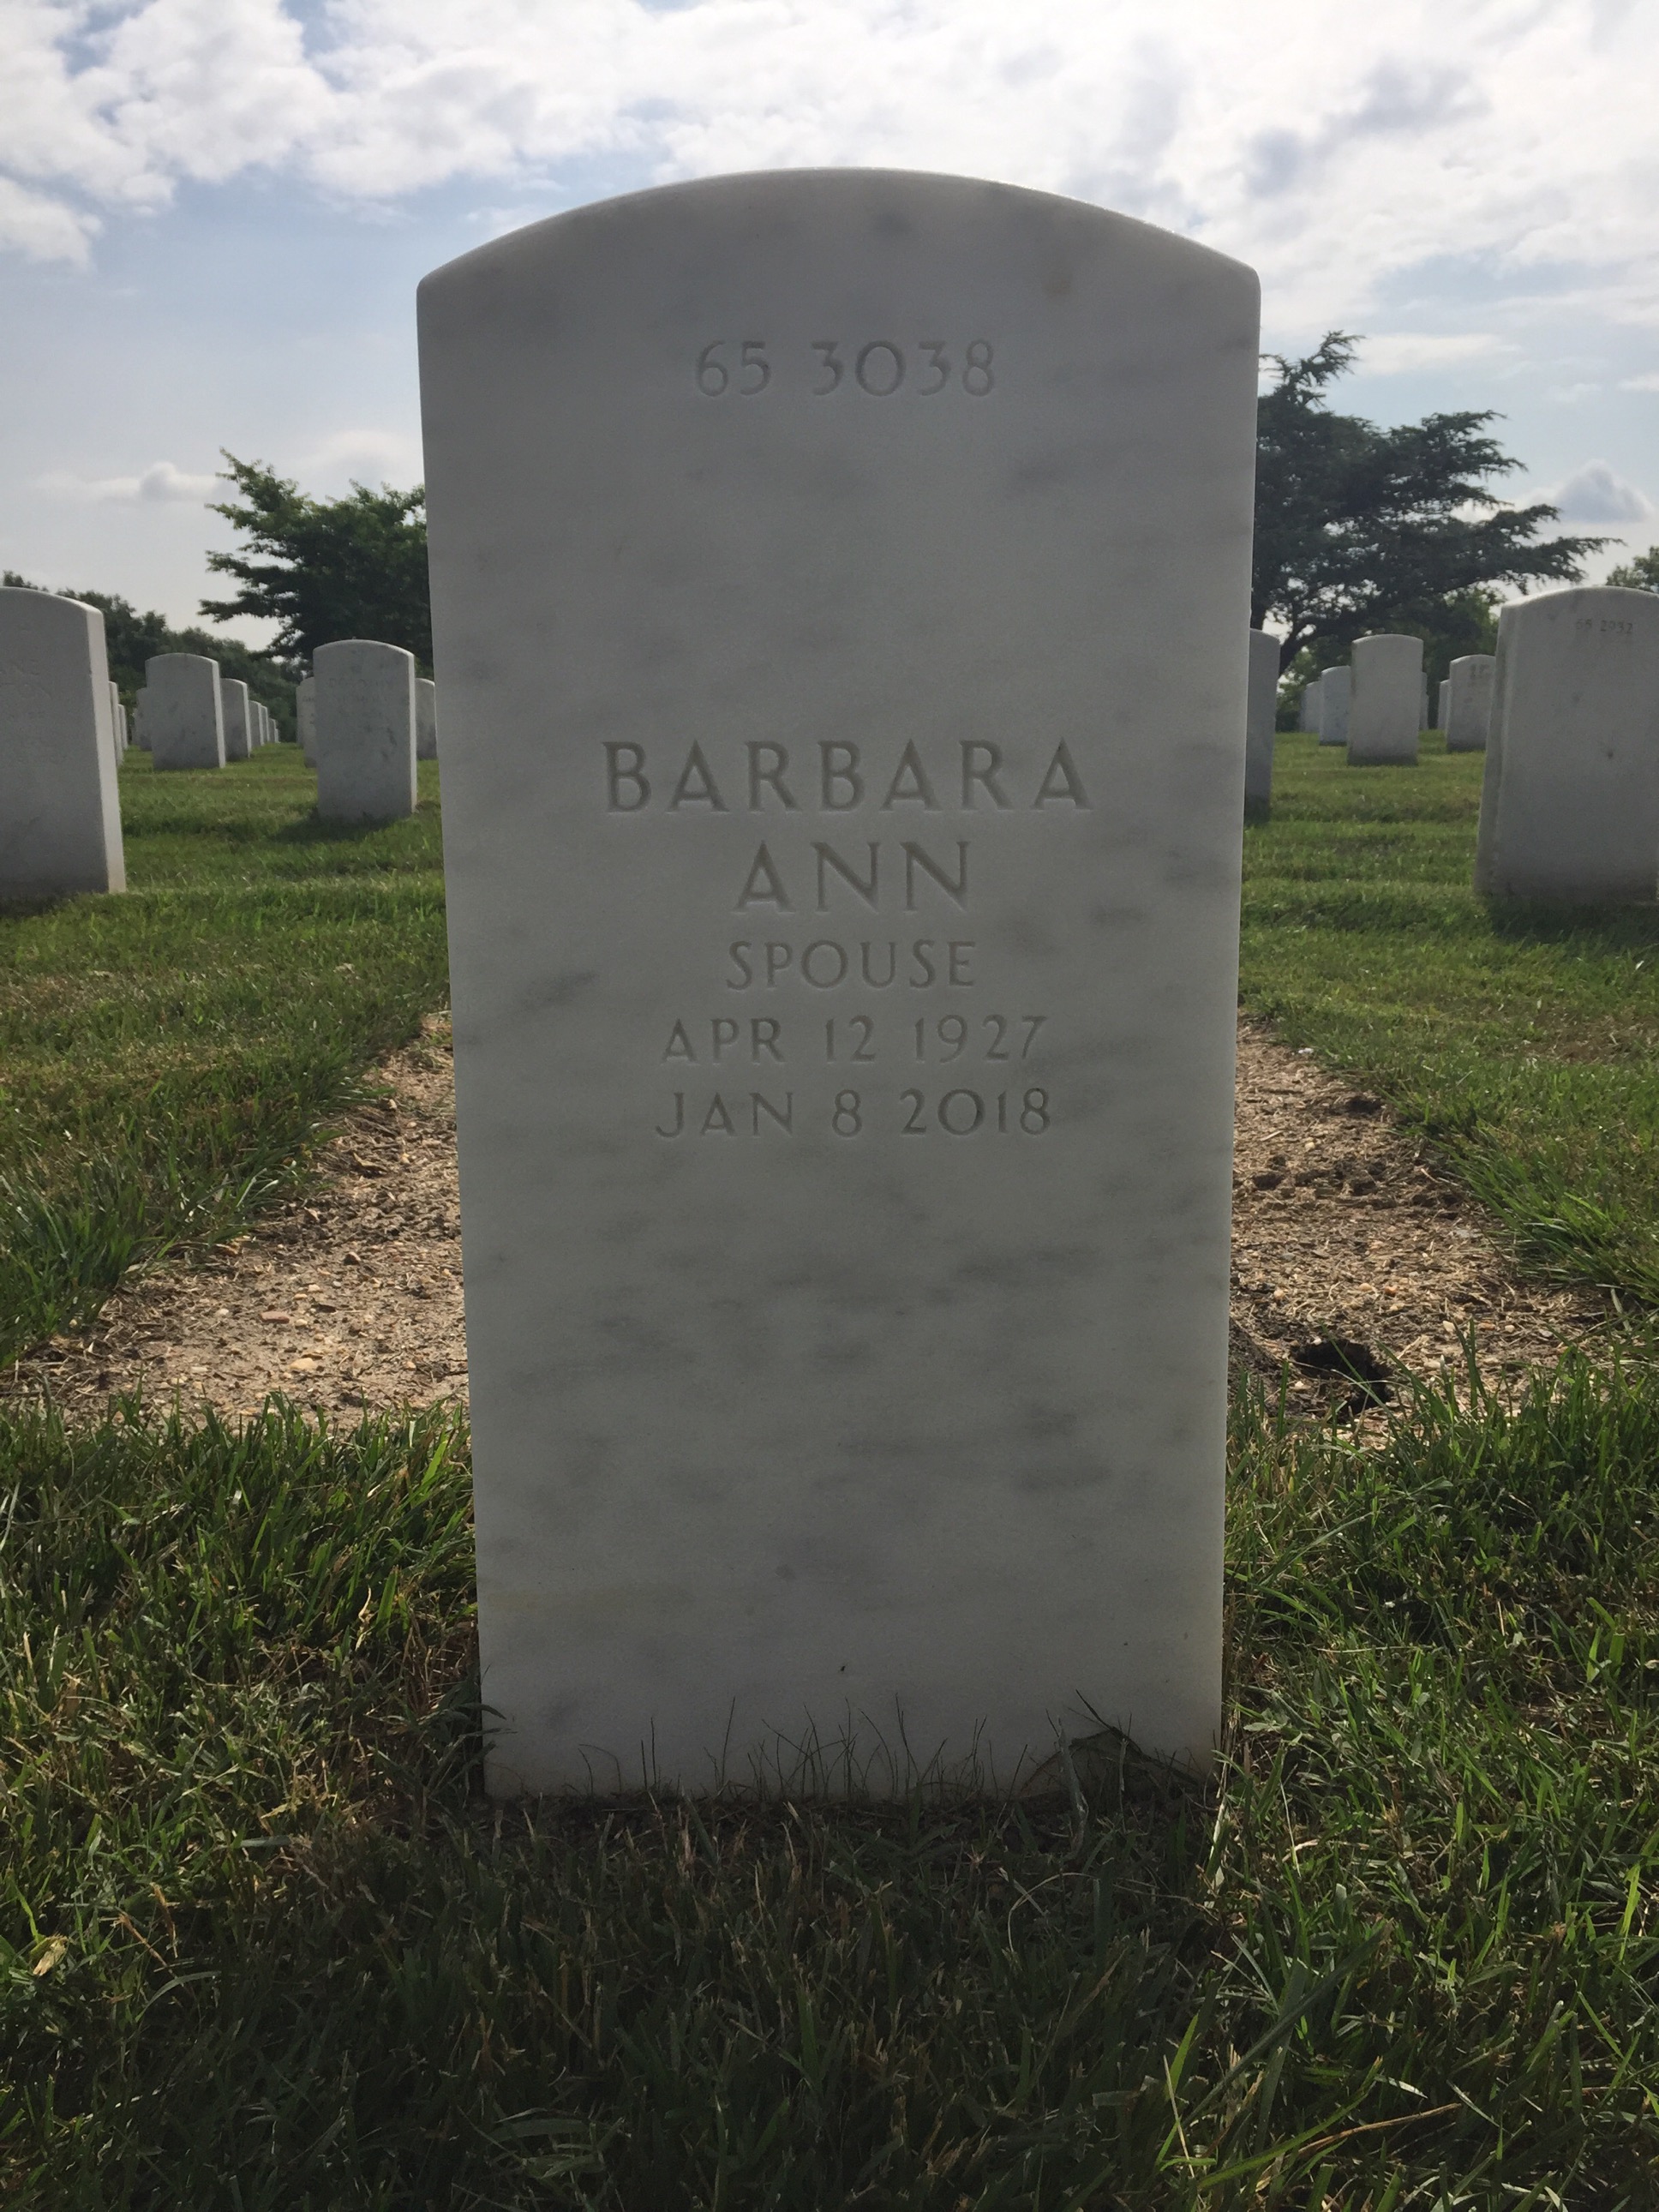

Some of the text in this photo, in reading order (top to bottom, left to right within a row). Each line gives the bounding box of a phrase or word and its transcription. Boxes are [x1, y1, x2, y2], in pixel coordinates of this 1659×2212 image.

[696, 339, 994, 397] 65 3038
[602, 738, 1093, 813] BARBARA
[731, 841, 970, 914] ANN
[725, 939, 976, 991] SPOUSE
[661, 1014, 1047, 1064] APR 12 1927
[656, 1087, 1051, 1138] JAN 8 2018
